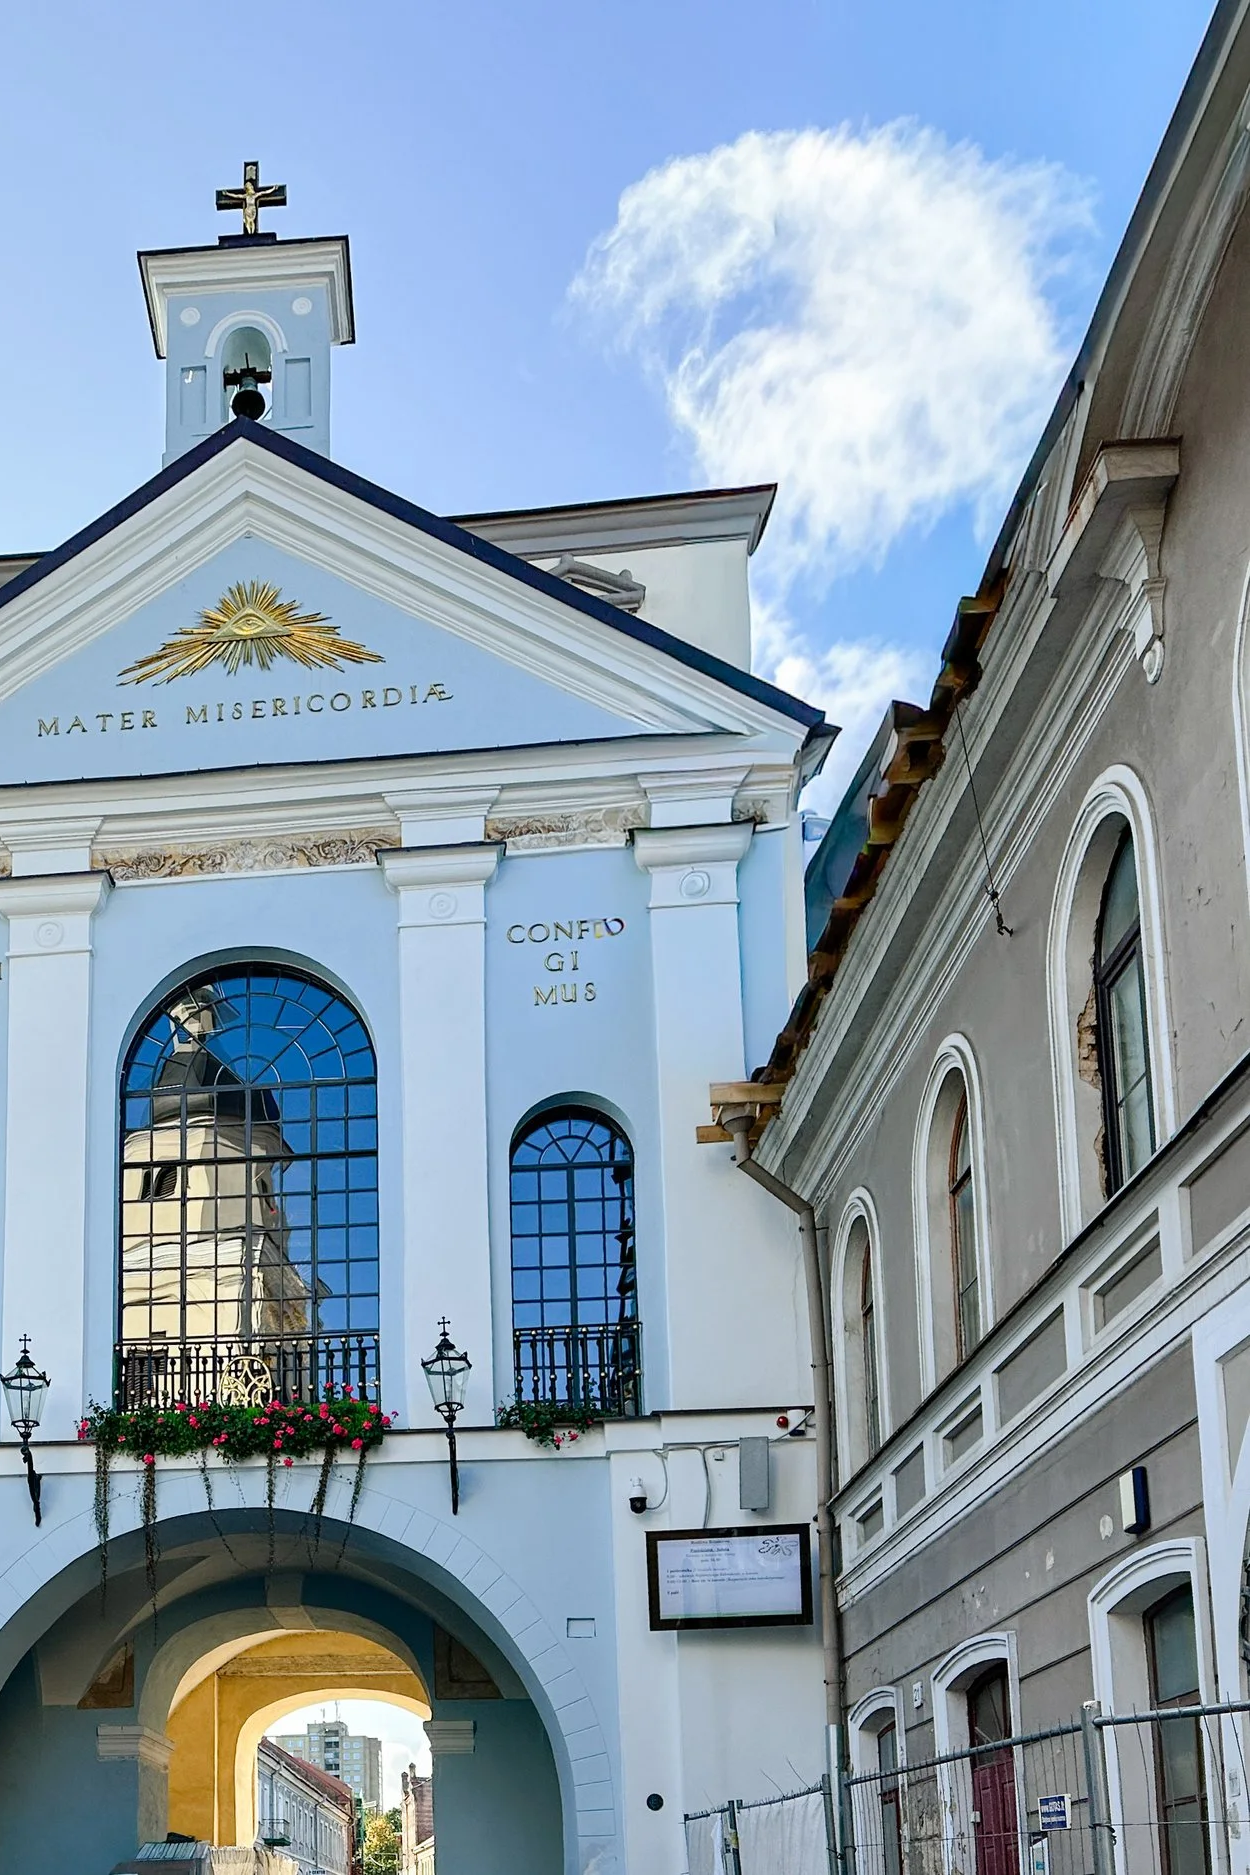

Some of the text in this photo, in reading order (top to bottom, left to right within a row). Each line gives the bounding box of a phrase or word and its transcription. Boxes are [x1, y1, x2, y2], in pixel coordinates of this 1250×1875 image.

[37, 682, 455, 738] MATER MISERICORDIÆ
[543, 949, 580, 973] GI
[533, 981, 597, 1008] MUS
